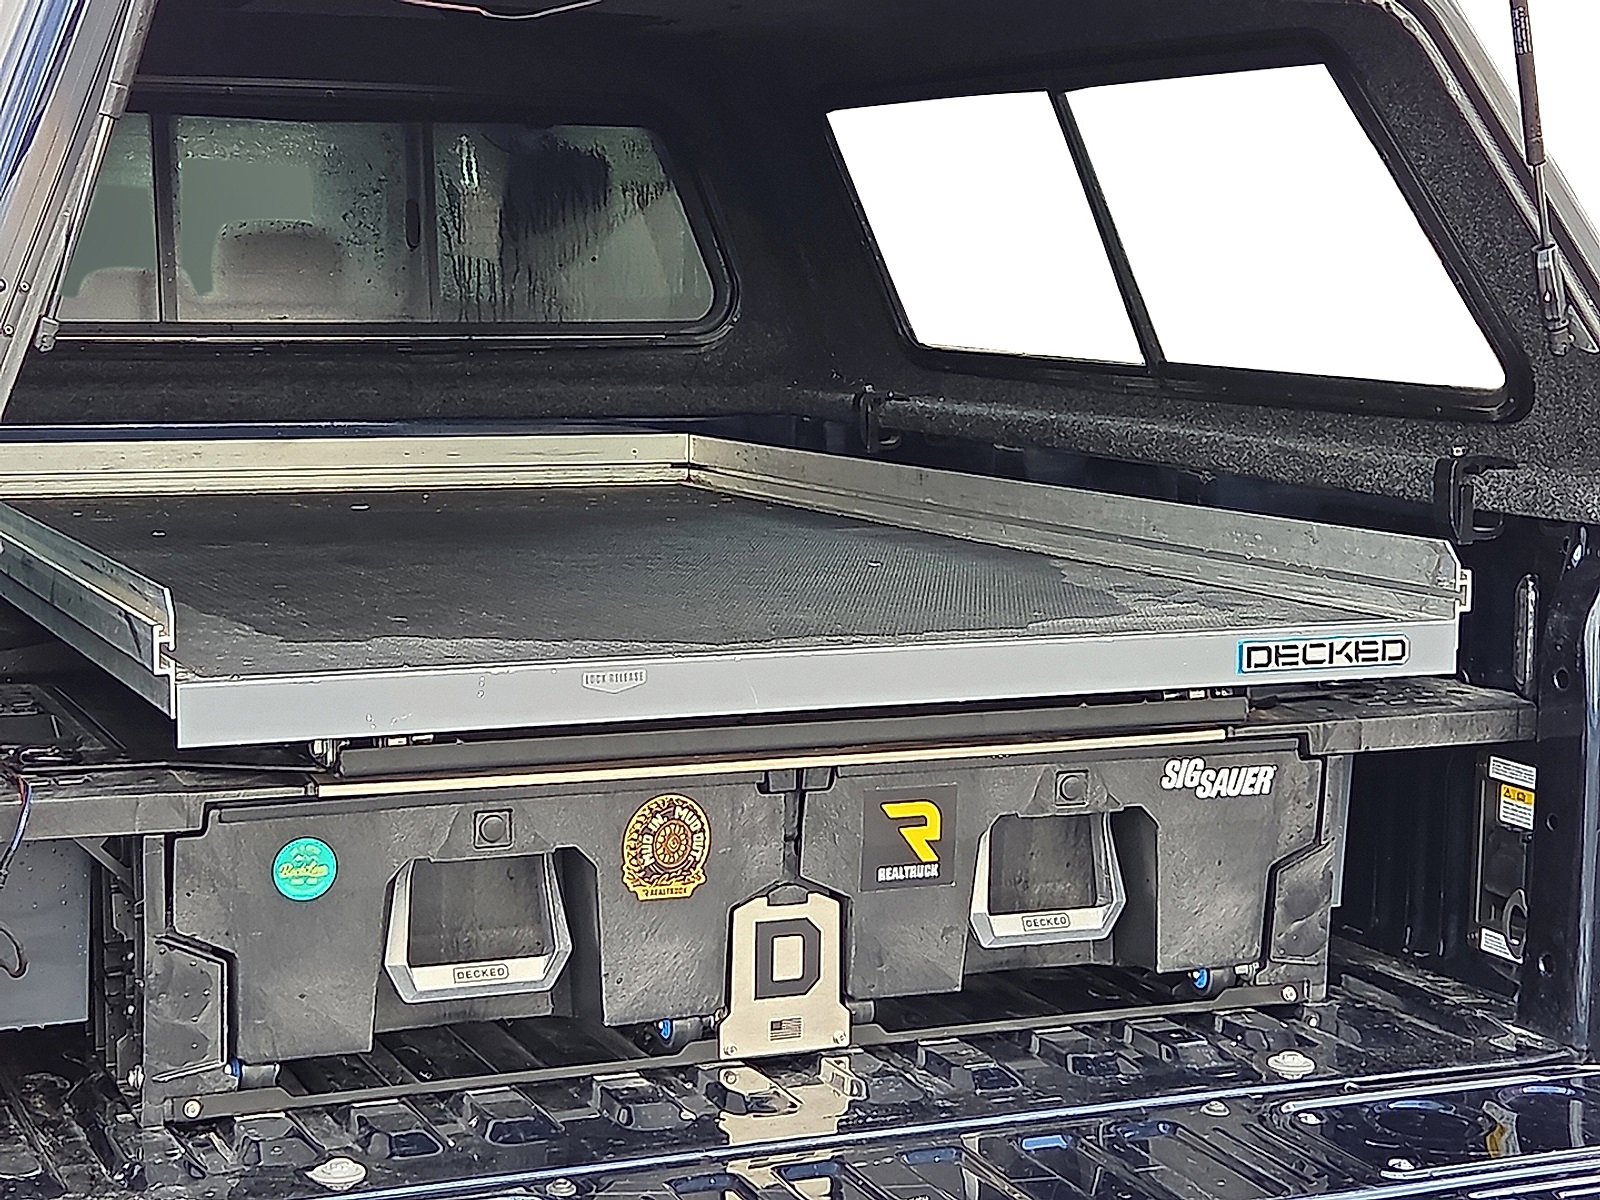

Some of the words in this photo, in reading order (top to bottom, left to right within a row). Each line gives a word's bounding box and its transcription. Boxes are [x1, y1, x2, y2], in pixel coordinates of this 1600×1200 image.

[1245, 639, 1406, 669] DECKED
[609, 671, 644, 683] RELEASE
[1160, 757, 1206, 789] SIG
[1195, 765, 1275, 799] SAUER
[641, 834, 656, 869] MUD
[674, 805, 702, 834] MUD
[689, 832, 704, 861] OUT
[877, 863, 939, 882] REALTRUCK
[1025, 916, 1067, 928] DECKED
[754, 917, 822, 1000] D
[456, 967, 505, 980] DECKED
